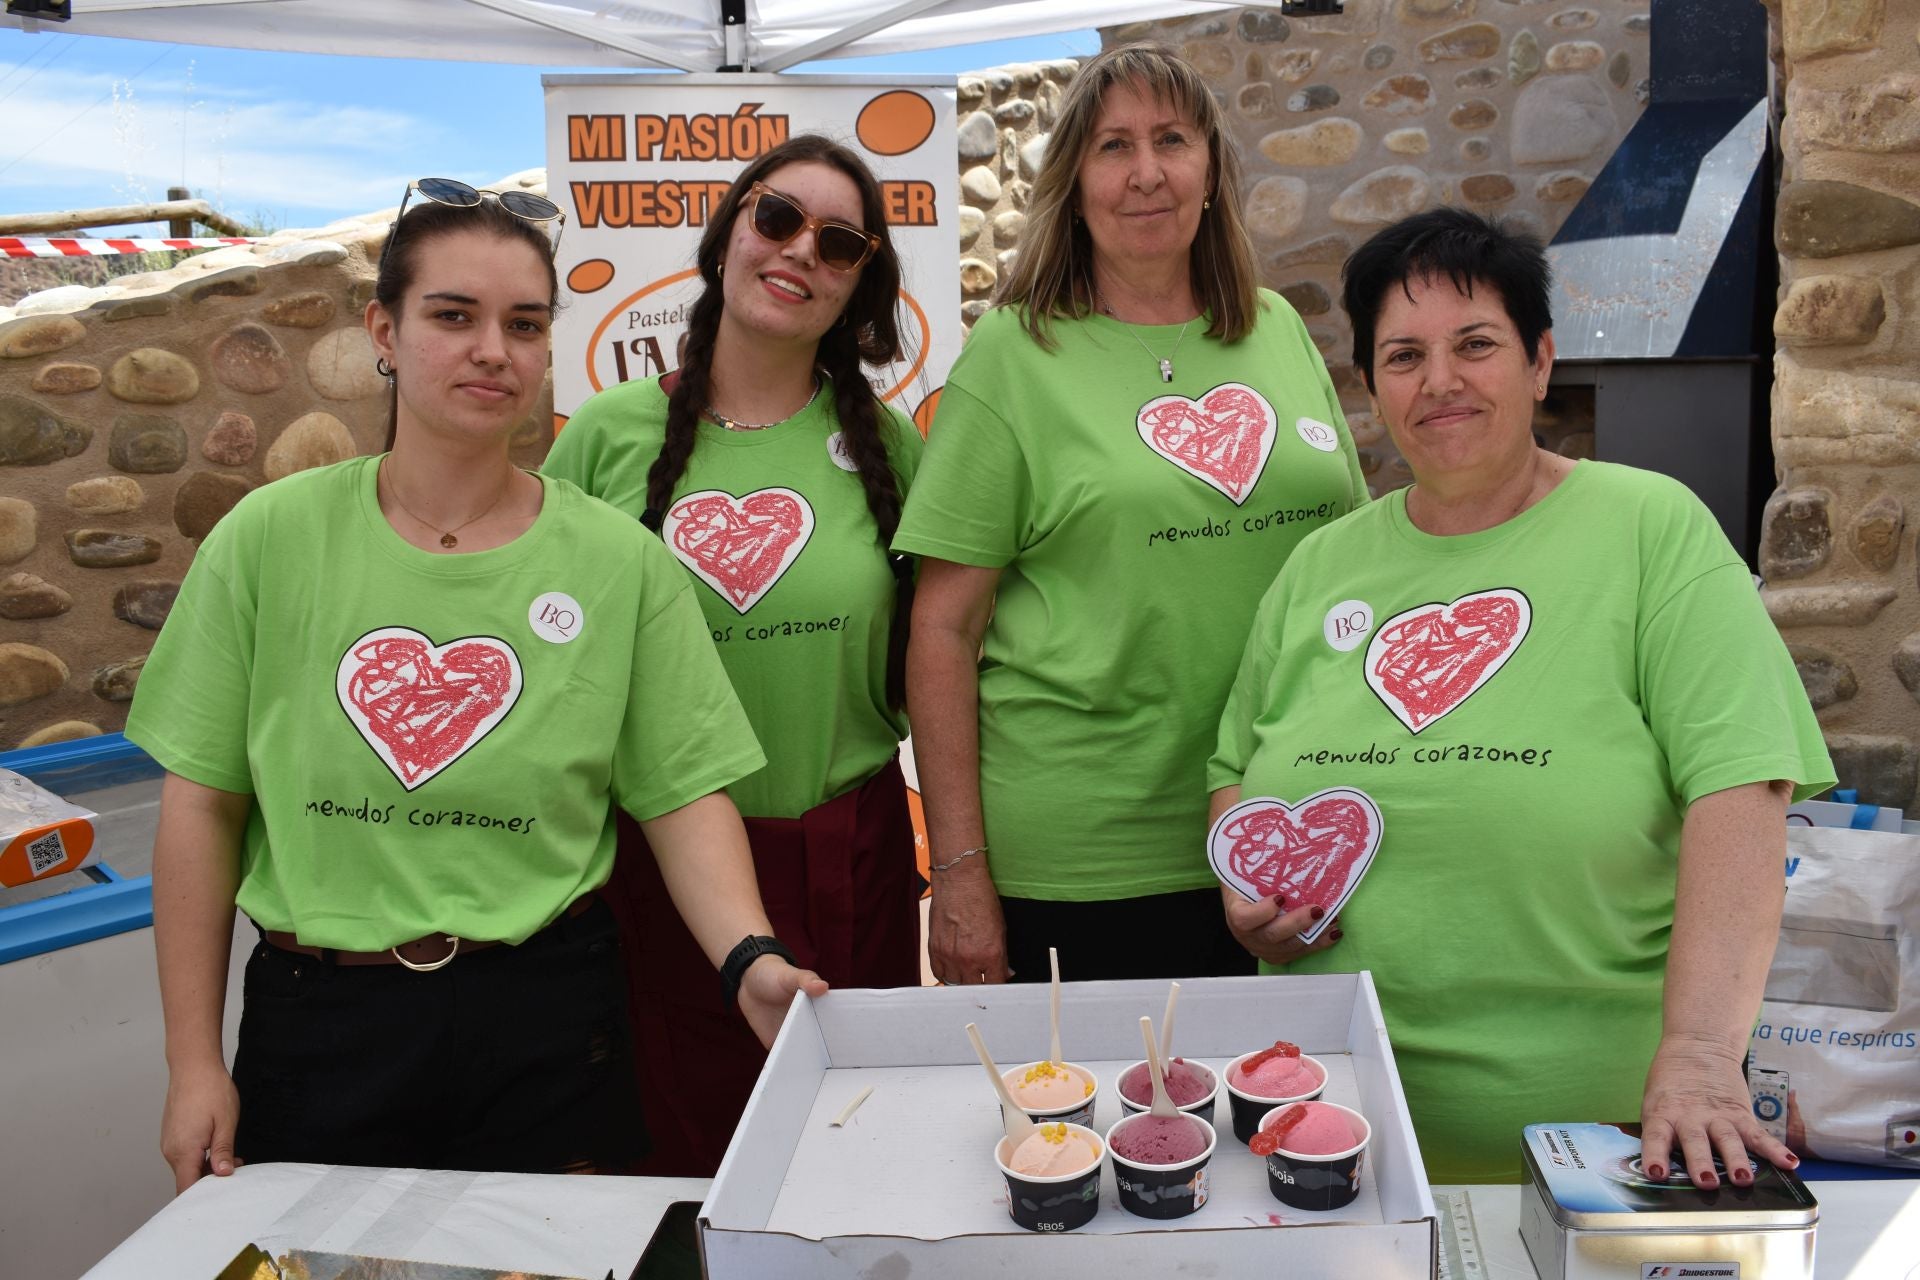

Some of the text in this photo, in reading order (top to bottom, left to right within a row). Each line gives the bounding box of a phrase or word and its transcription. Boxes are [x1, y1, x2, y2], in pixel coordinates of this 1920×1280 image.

[568, 102, 790, 162] MI PASIÓN
[569, 180, 738, 228] VUEST
[1149, 501, 1336, 546] menudos corazones
[537, 601, 575, 638] BQ
[746, 615, 849, 641] corazones
[1334, 611, 1368, 639] BQ
[1294, 743, 1552, 767] menudos corazones
[305, 797, 536, 834] menudos corazones
[1780, 1026, 1822, 1045] que
[1829, 1030, 1916, 1050] respiras
[1269, 1162, 1294, 1185] Rioja
